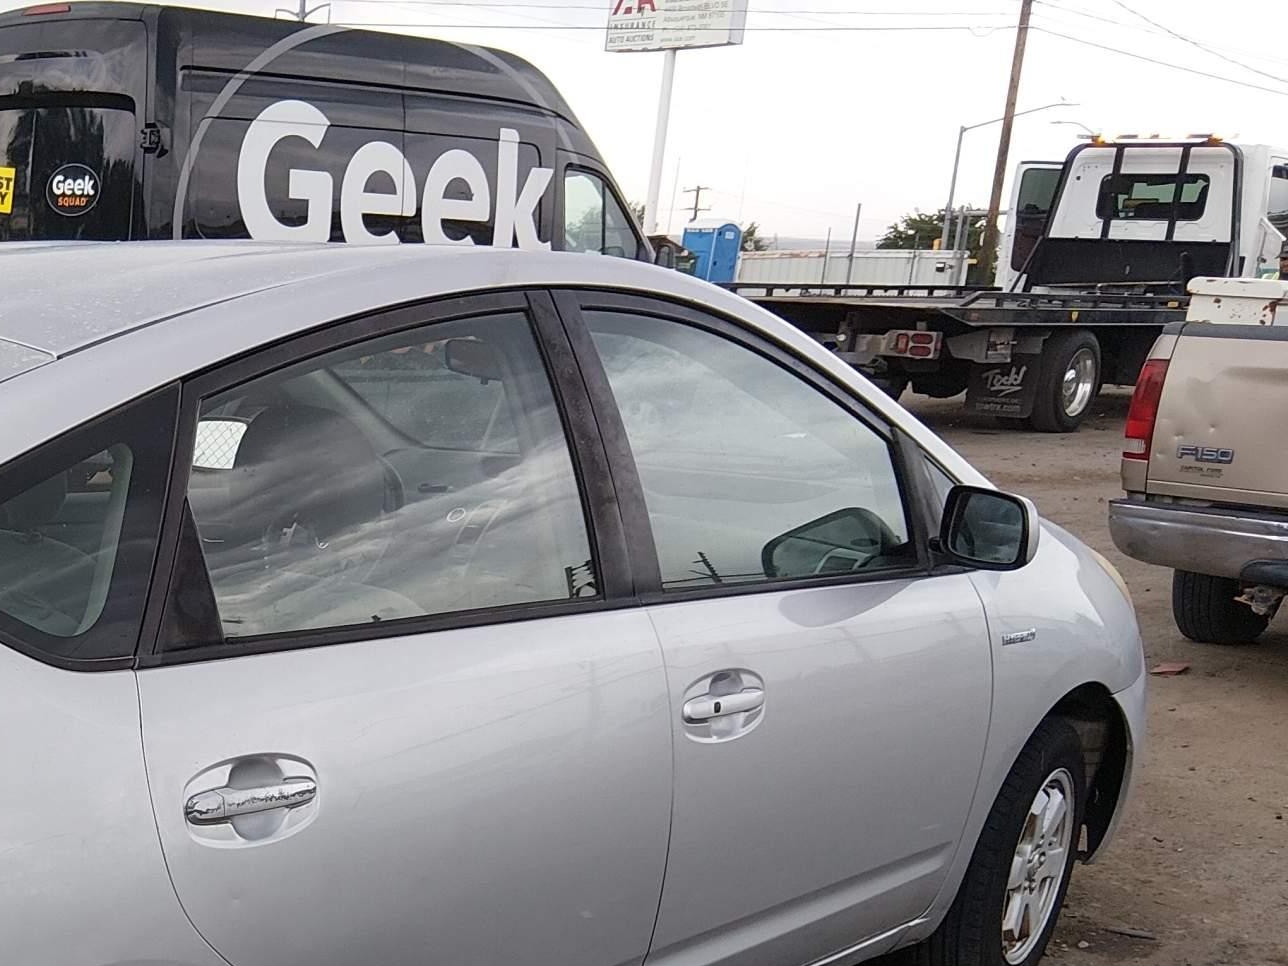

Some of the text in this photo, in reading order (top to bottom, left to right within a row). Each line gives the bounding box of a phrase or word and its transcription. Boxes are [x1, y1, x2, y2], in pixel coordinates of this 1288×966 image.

[610, 20, 656, 29] INSURANCE
[52, 174, 95, 196] Geek
[237, 99, 554, 250] Geek
[57, 196, 88, 207] SQUAD
[982, 365, 1028, 390] Todd
